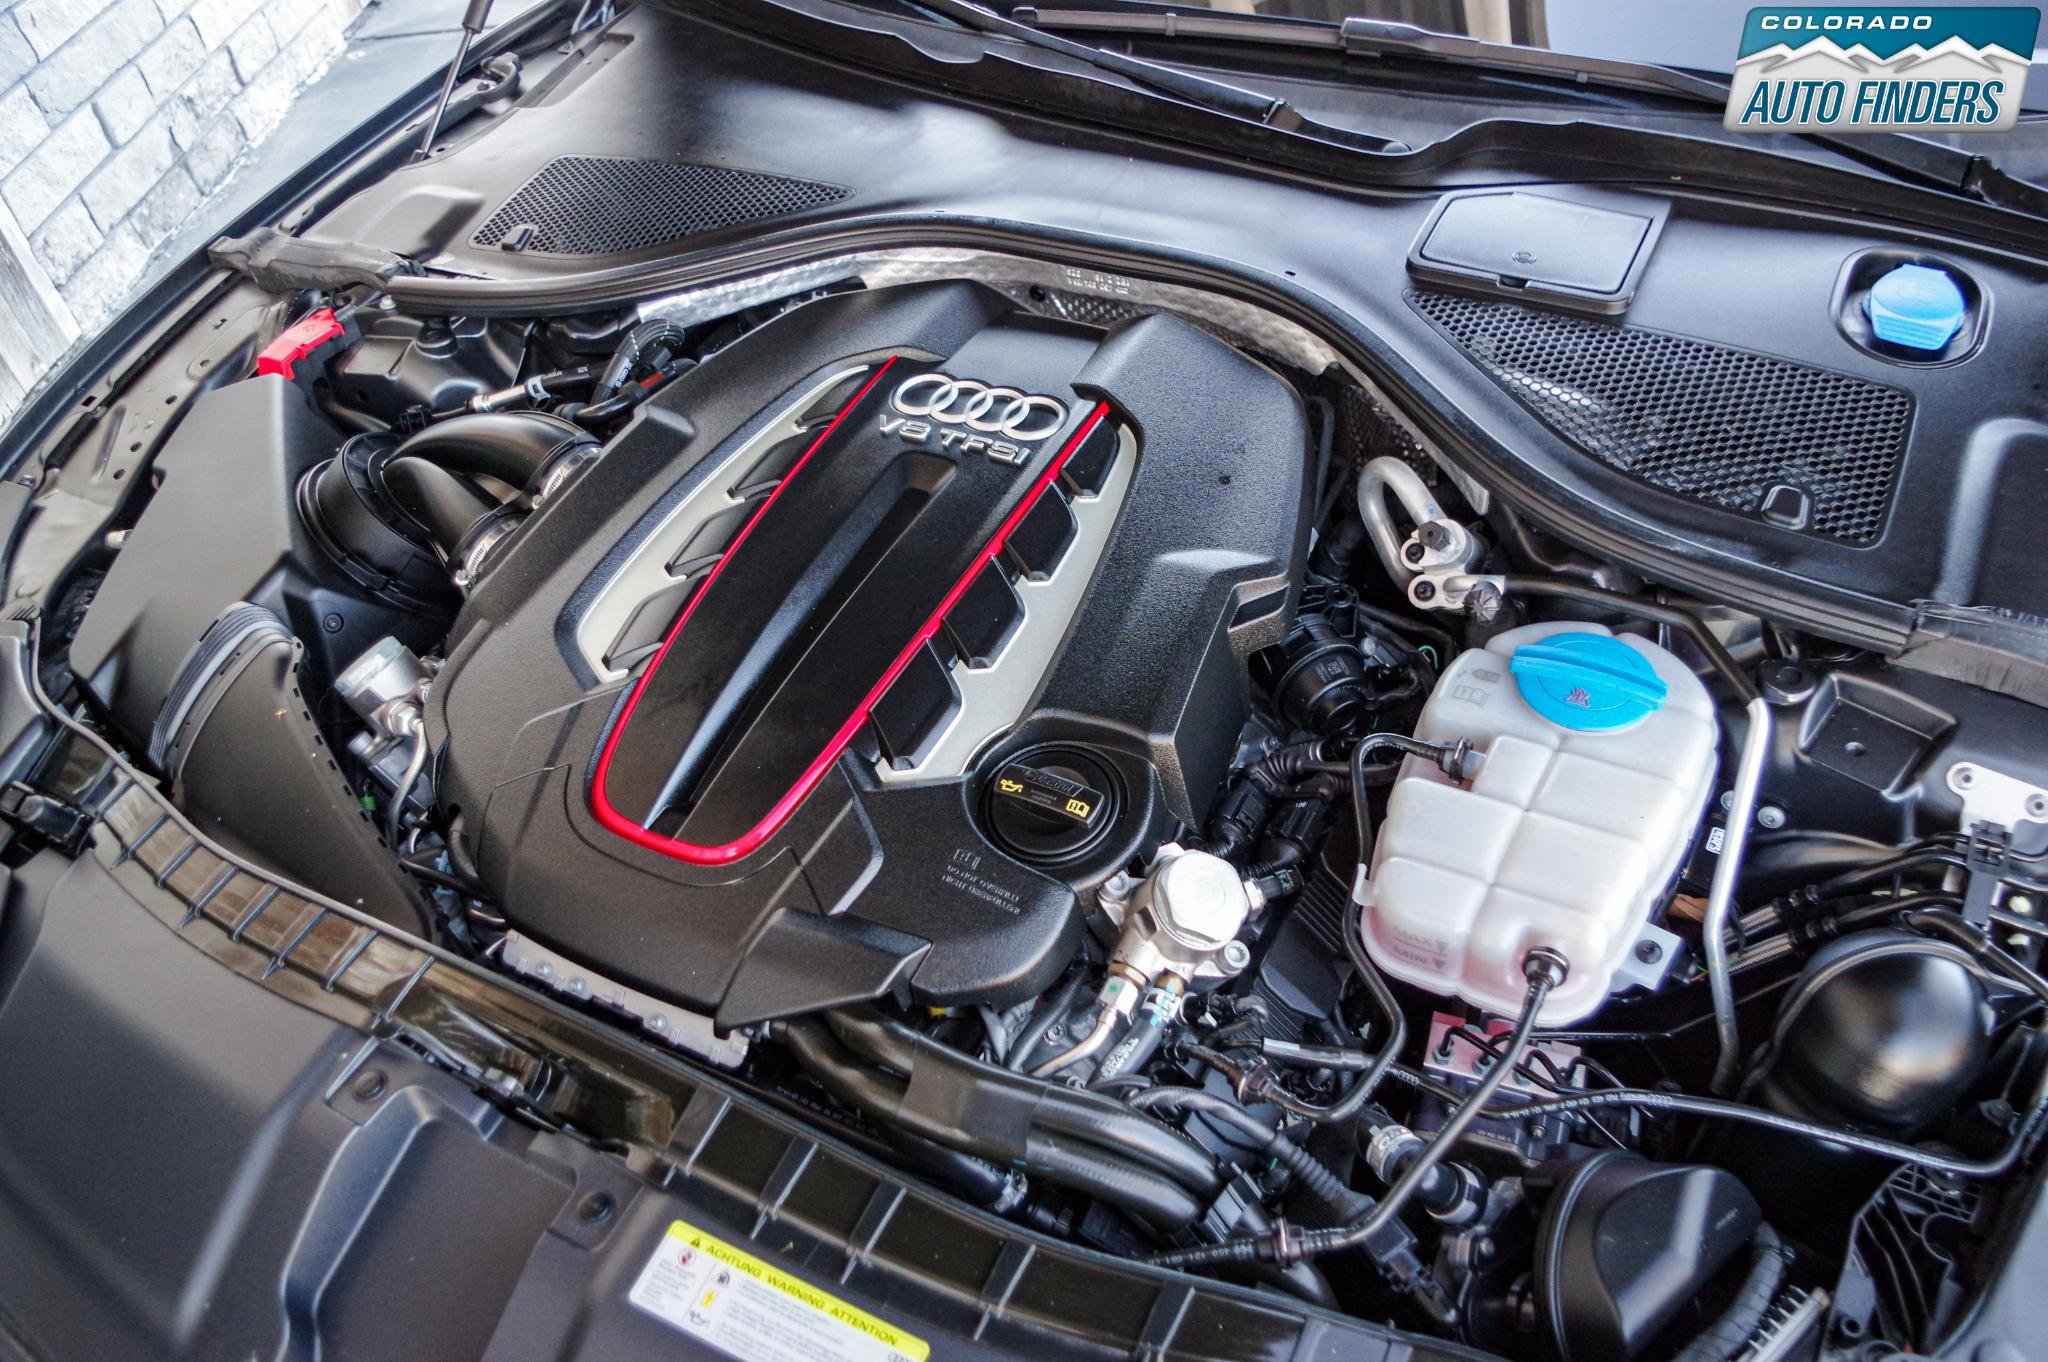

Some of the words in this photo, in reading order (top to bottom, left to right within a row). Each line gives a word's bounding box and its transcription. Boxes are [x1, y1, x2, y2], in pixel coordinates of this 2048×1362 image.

[880, 414, 931, 443] V8
[940, 427, 1030, 466] TFSI
[1392, 945, 1428, 965] MIN
[705, 1244, 762, 1278] ACHTUNG
[767, 1273, 825, 1309] WARNING
[829, 1307, 899, 1346] ATTENTION
